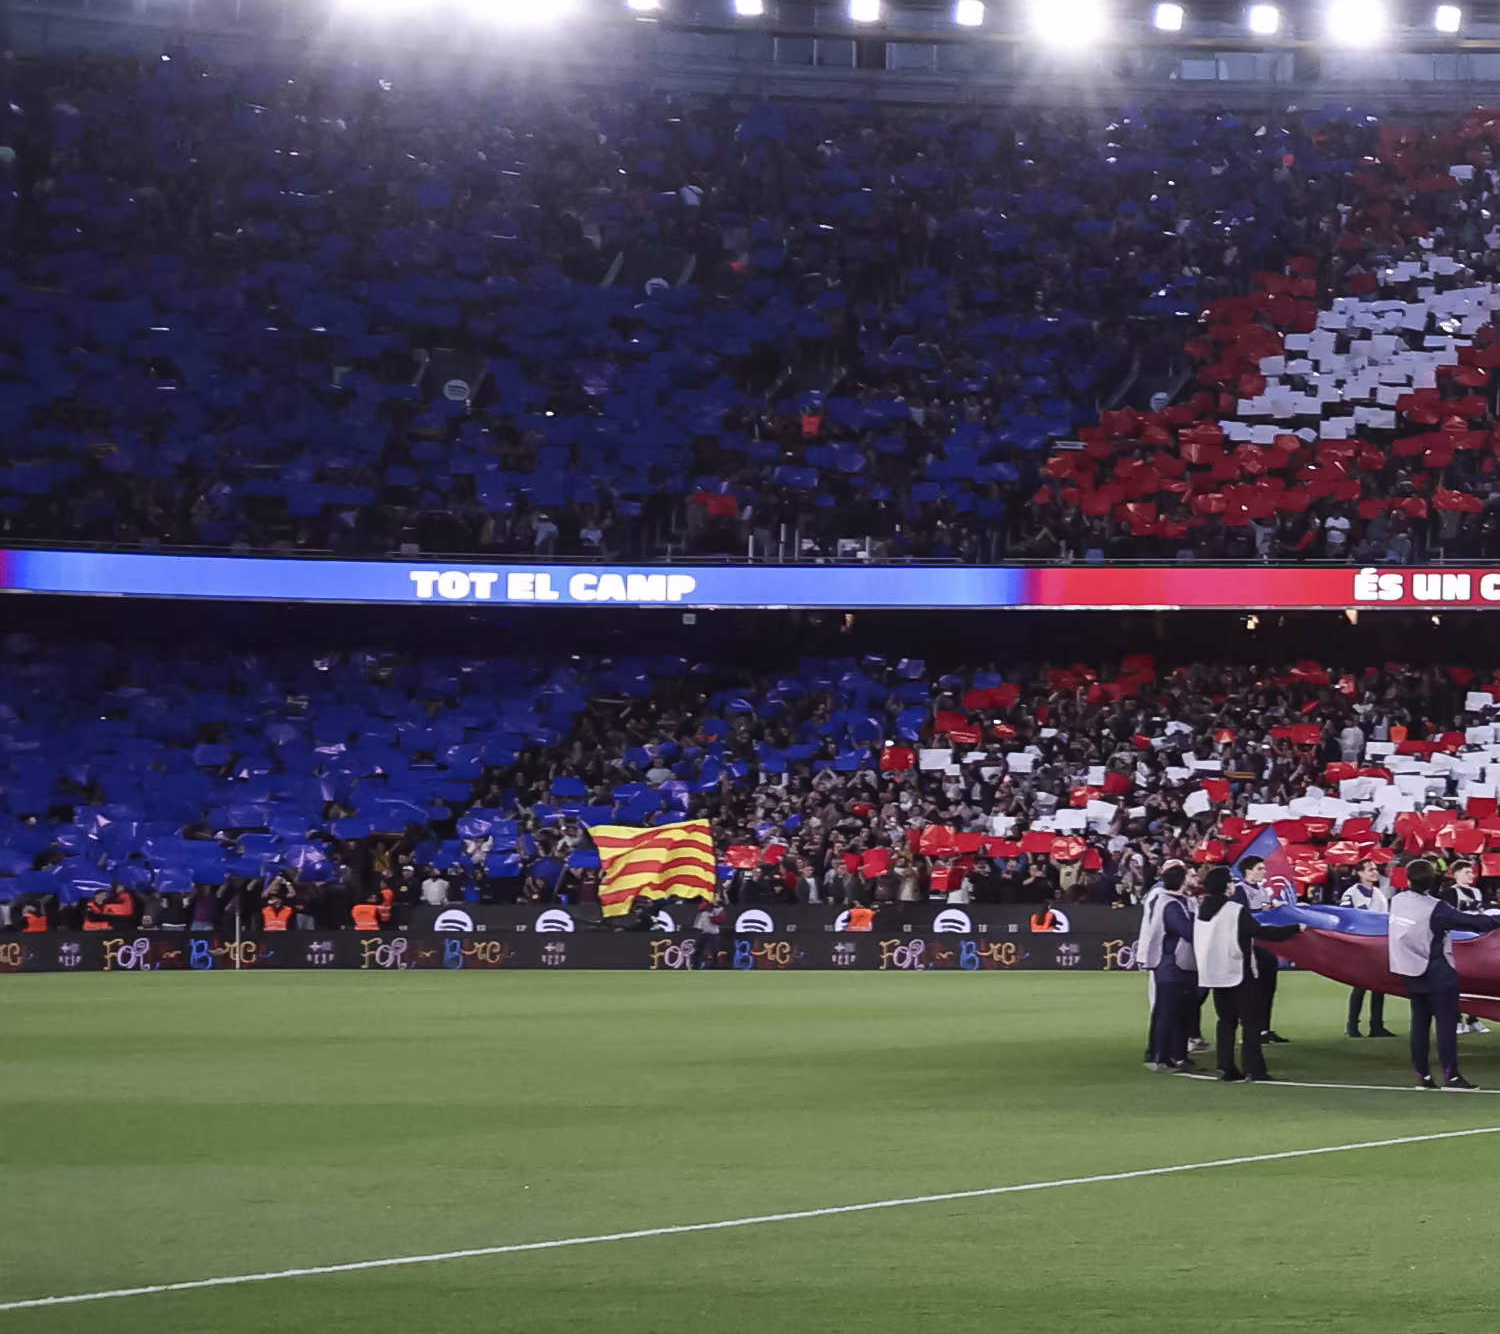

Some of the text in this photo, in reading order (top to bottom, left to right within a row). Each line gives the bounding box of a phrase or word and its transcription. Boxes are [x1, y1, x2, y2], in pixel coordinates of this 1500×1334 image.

[409, 571, 696, 601] TOT EL CAMP
[1354, 568, 1403, 600] ÉS
[1412, 573, 1471, 600] UN
